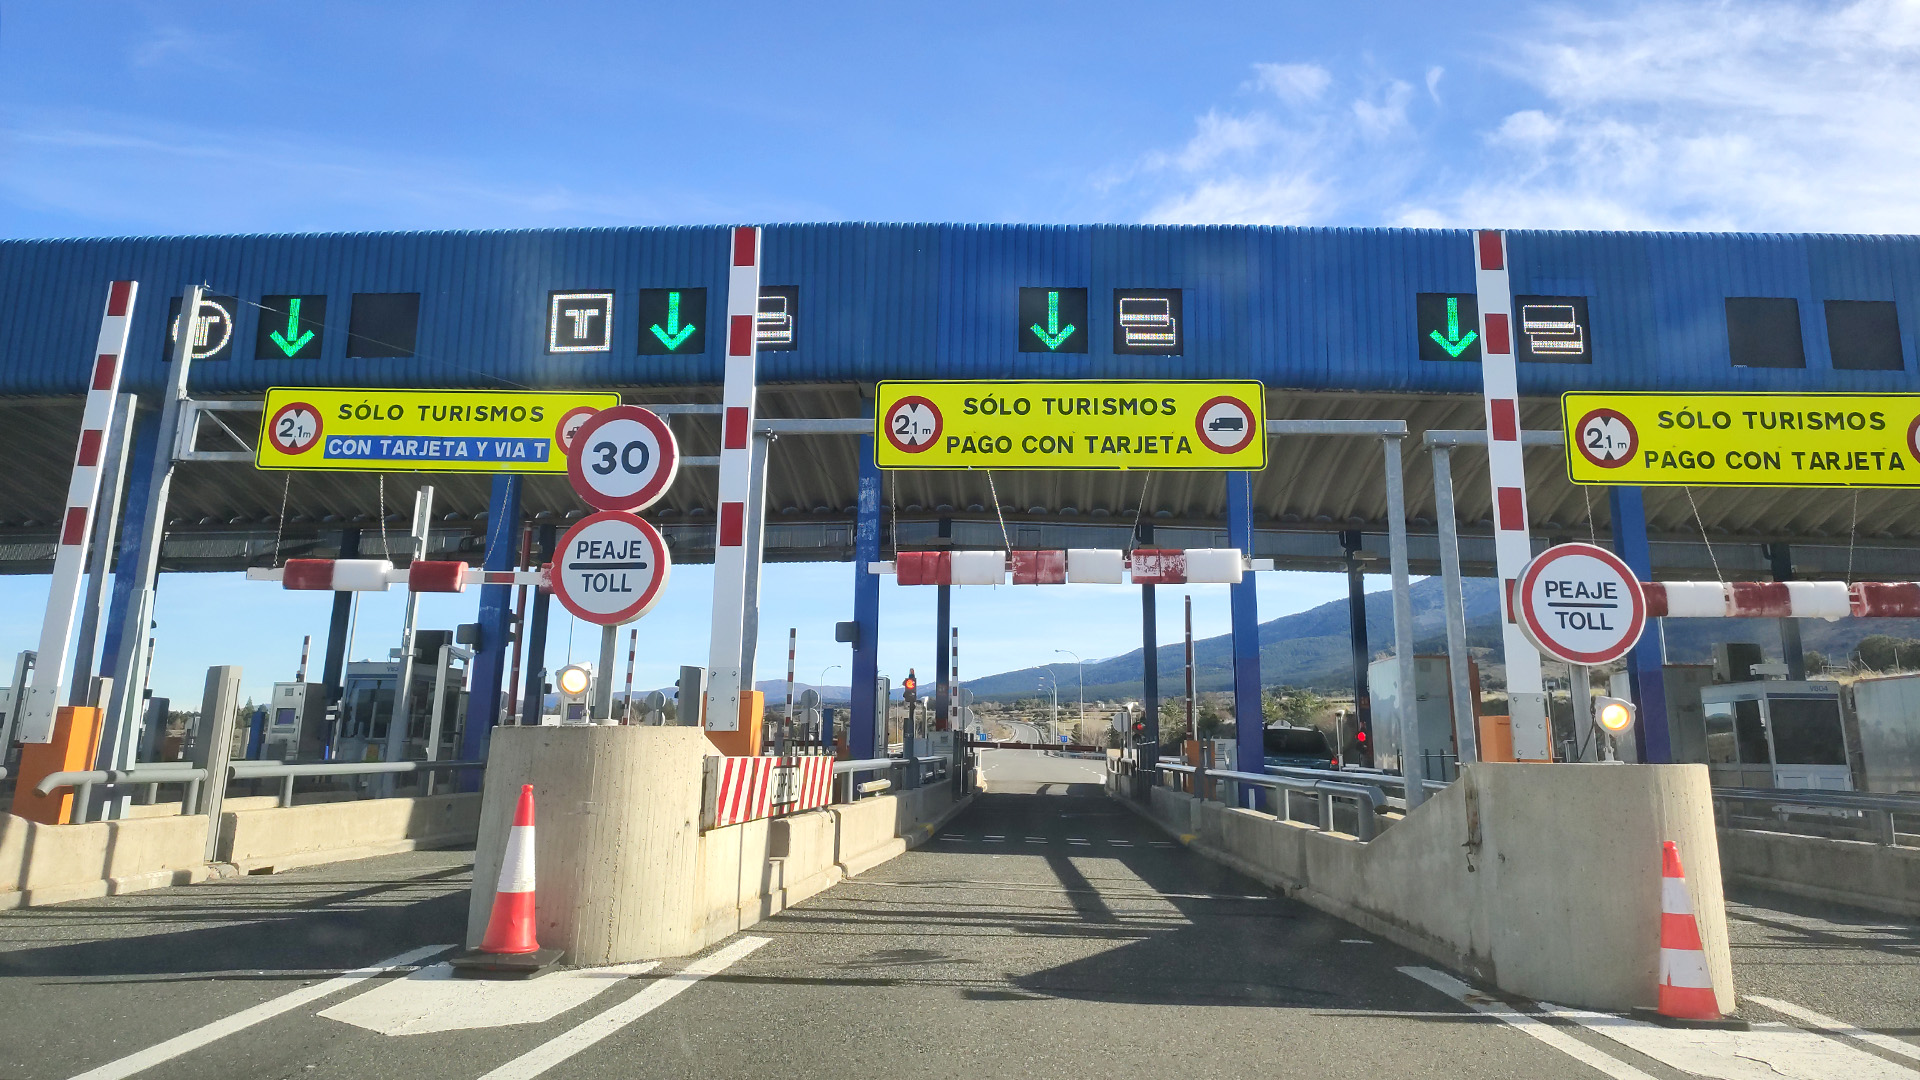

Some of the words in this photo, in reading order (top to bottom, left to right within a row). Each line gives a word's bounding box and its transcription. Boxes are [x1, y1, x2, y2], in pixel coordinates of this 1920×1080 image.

[337, 399, 405, 420] SÓLO
[419, 404, 545, 423] TURISMOS
[963, 393, 1031, 416] SÓLO
[1042, 397, 1177, 416] TURISMOS
[1658, 406, 1731, 430] SÓLO
[1743, 411, 1886, 431] TURISMOS
[328, 439, 372, 456] CON
[379, 439, 468, 458] TARJETA
[476, 441, 489, 458] Y
[494, 441, 525, 458] VIA
[534, 443, 546, 459] T
[946, 435, 1012, 454] PAGO
[1021, 435, 1074, 454] CON
[1084, 435, 1193, 454] TARJETA
[592, 440, 650, 475] 30
[1645, 450, 1715, 470] PAGO
[1725, 451, 1781, 470] CON
[1791, 451, 1905, 471] TARJETA
[576, 540, 642, 560] PEAJE
[581, 573, 632, 593] TOLL
[1545, 580, 1618, 600] PEAJE
[1555, 611, 1614, 631] TOLL
